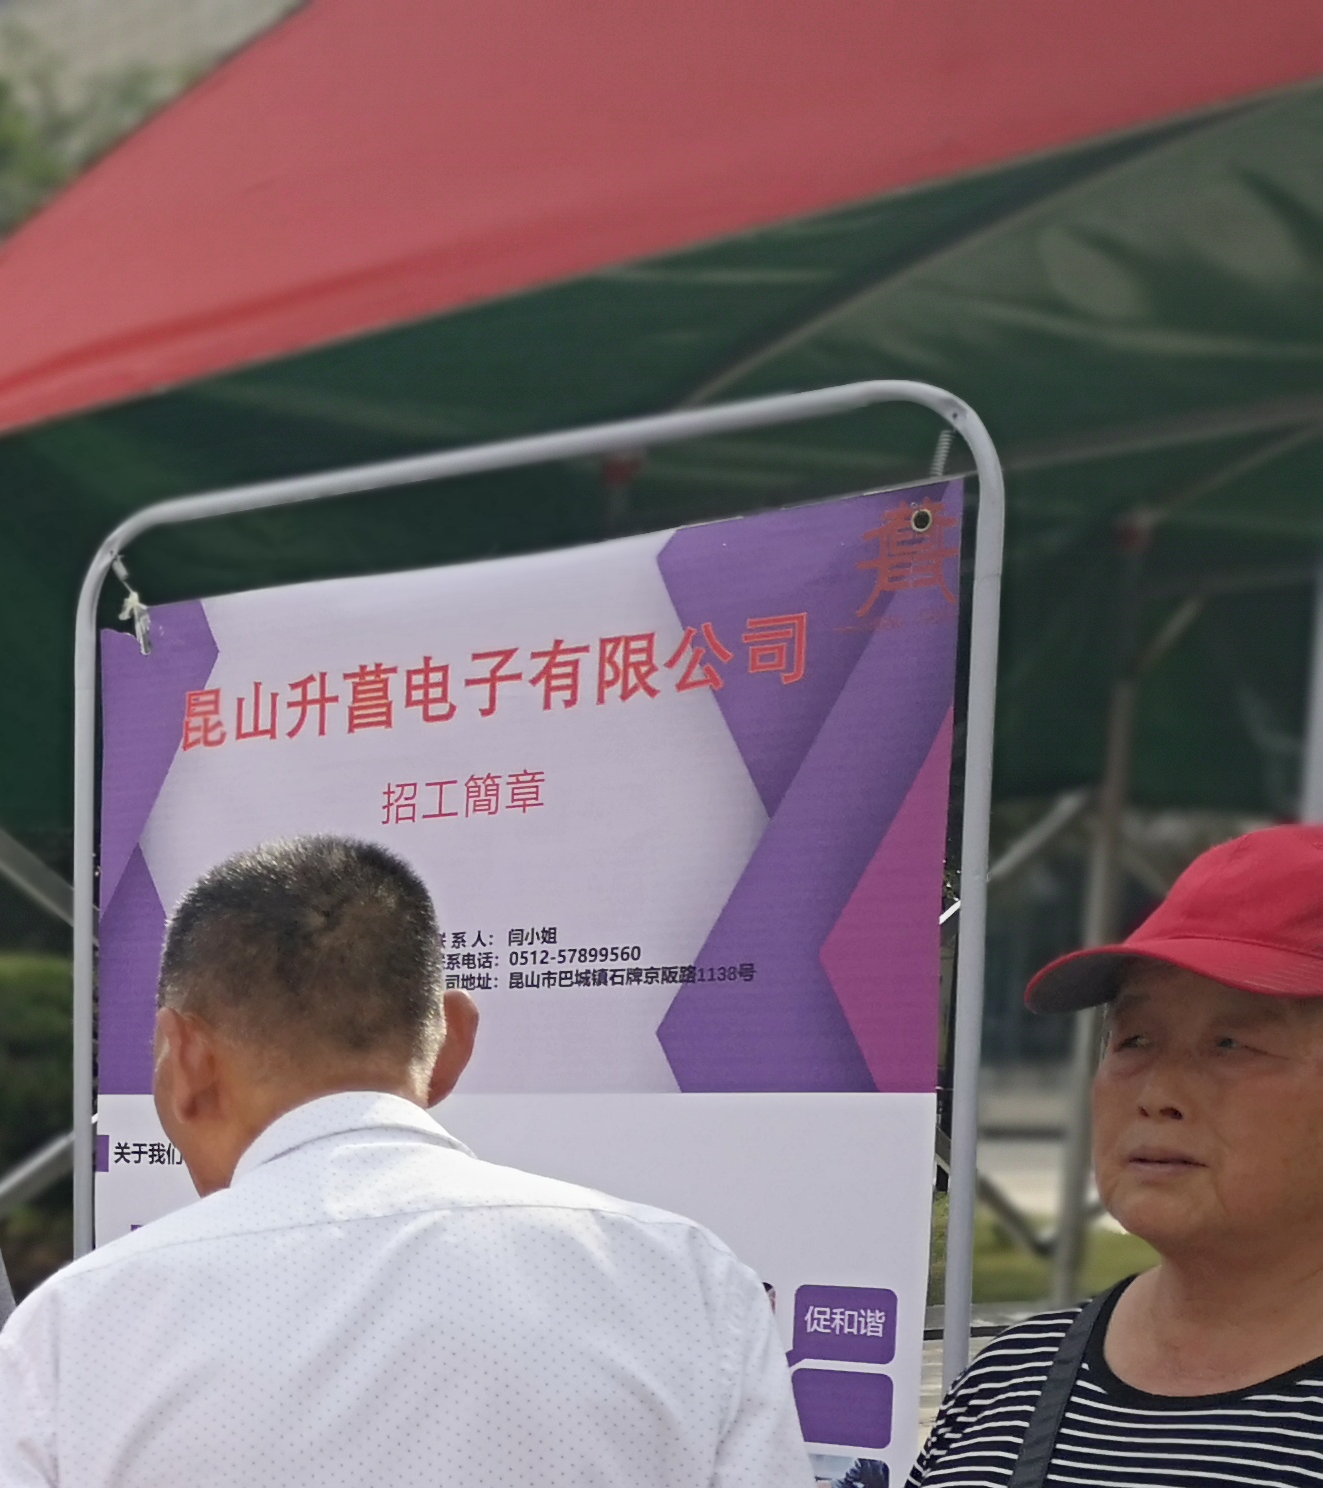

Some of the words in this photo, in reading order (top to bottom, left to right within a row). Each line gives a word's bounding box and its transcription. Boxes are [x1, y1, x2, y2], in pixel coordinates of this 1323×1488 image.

[181, 612, 808, 751] 昆山升菖电子有限公司
[381, 769, 546, 825] 招工簡章
[804, 1306, 887, 1339] 促和谐
